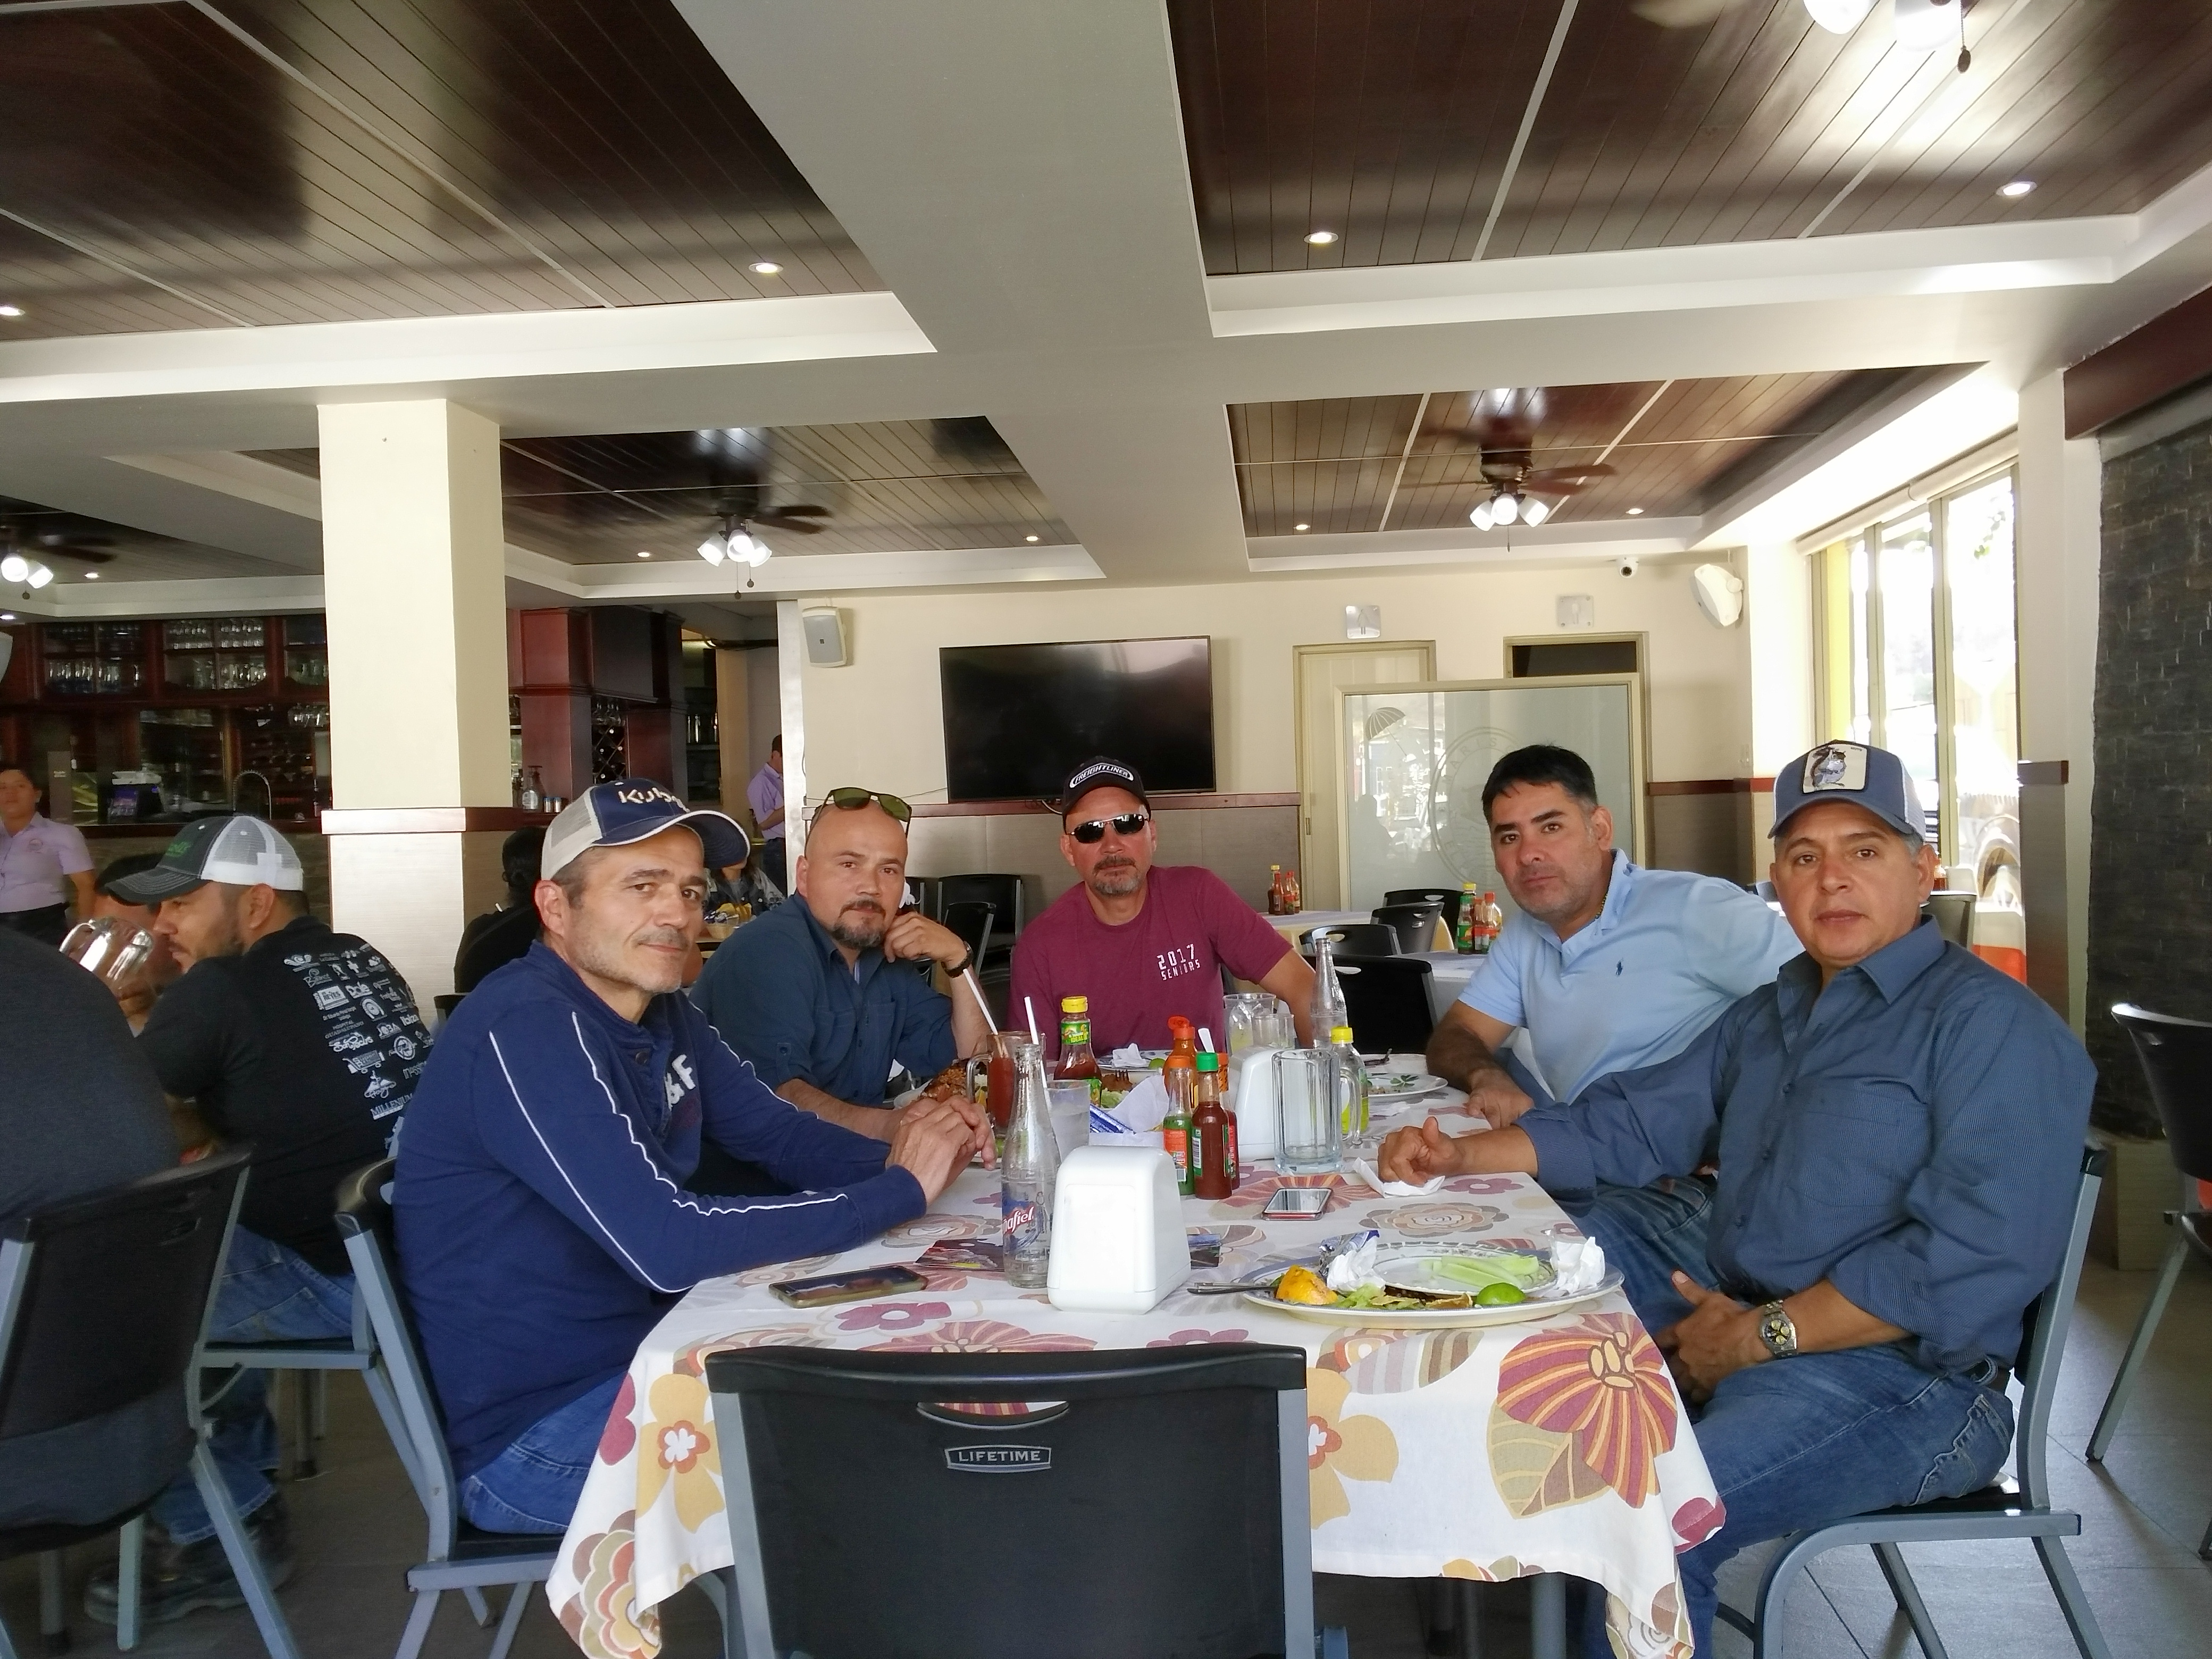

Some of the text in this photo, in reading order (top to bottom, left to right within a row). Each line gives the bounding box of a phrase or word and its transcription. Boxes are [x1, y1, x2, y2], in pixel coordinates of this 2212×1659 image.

[1075, 764, 1129, 784] FREIGHTLINER
[617, 787, 691, 814] Kub
[1157, 943, 1195, 970] 2017
[1161, 959, 1201, 981] SENIORS
[958, 1451, 1041, 1462] LIFETIME
